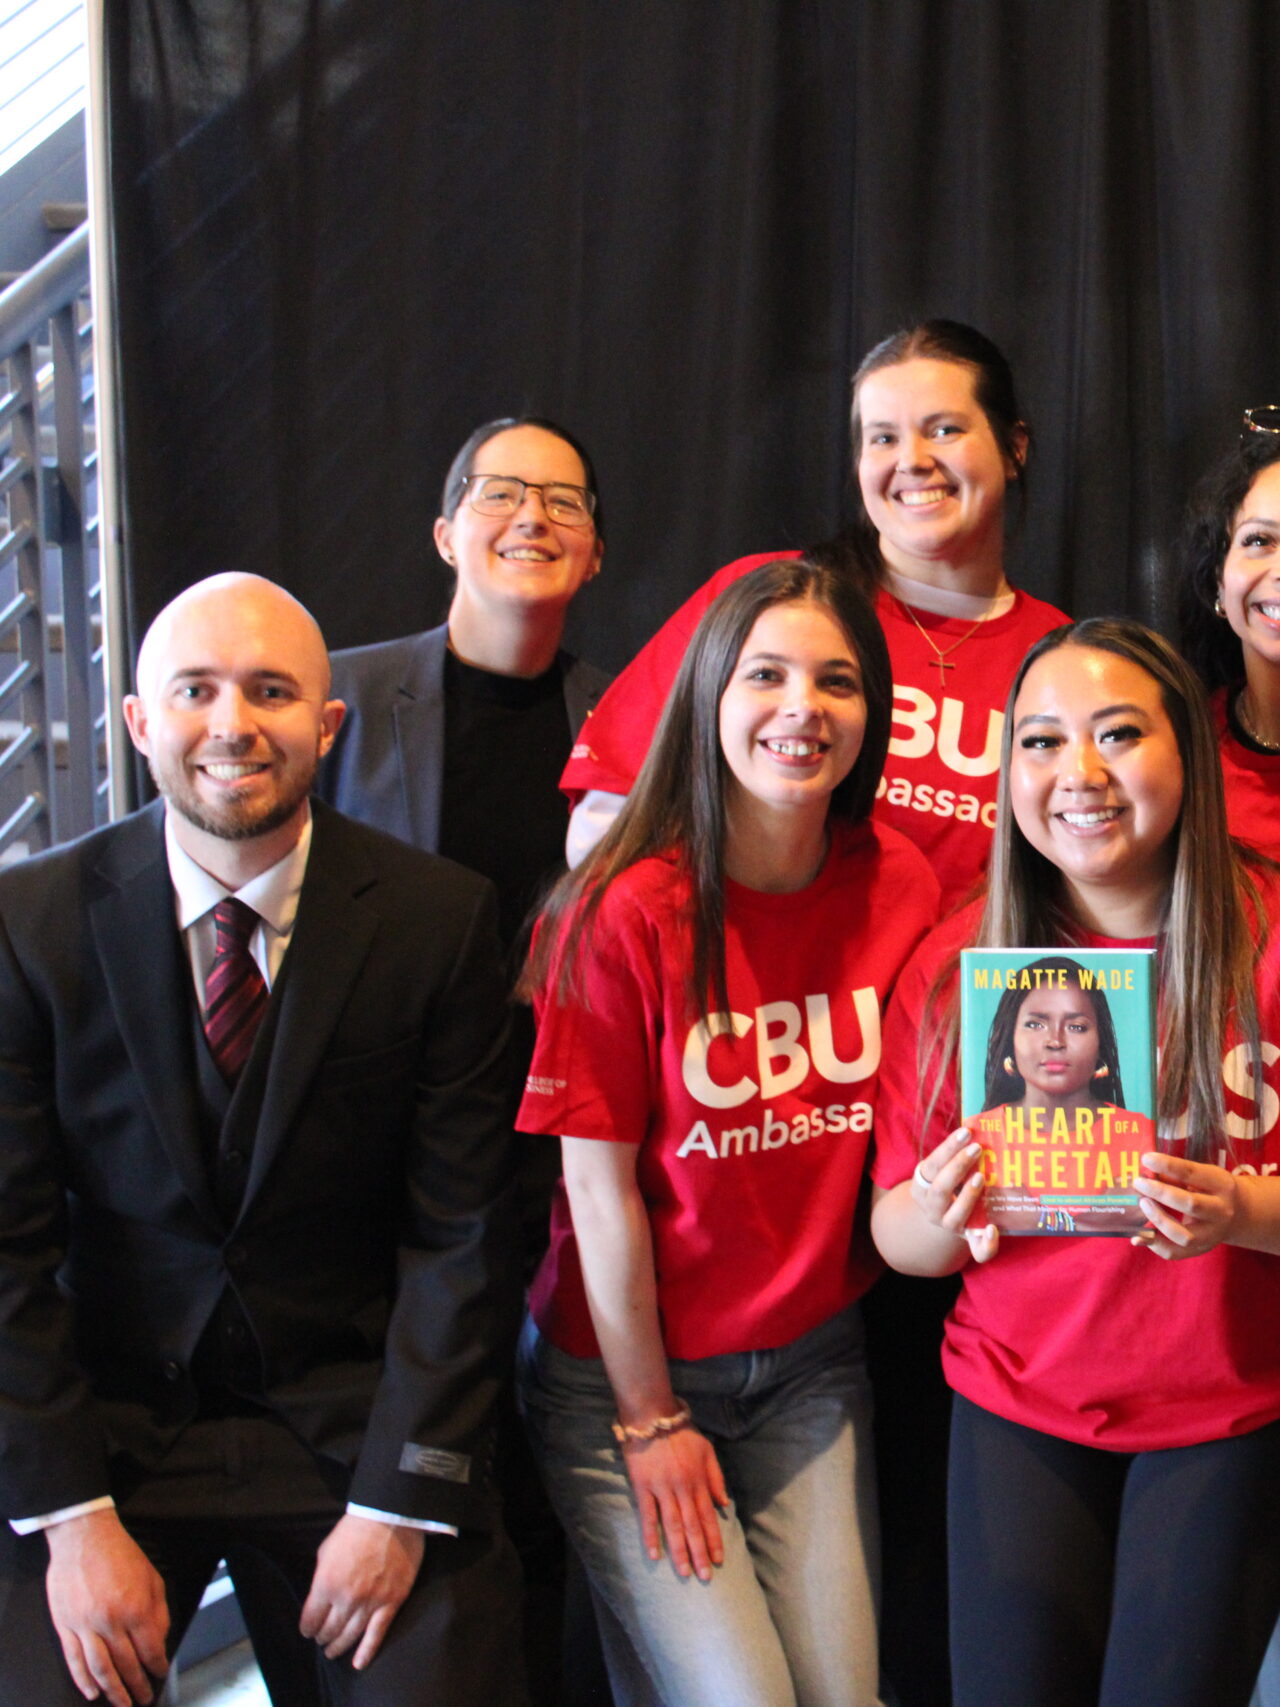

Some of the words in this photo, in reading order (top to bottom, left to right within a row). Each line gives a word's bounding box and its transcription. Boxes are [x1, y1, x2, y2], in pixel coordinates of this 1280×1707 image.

[887, 684, 1005, 777] BU
[974, 969, 1067, 990] MAGATTE
[1078, 969, 1135, 990] WADE
[682, 986, 882, 1109] CBU
[676, 1102, 873, 1159] Ambassa
[980, 1119, 1001, 1132] THE
[1005, 1107, 1116, 1144] HEART
[1114, 1121, 1129, 1134] OF
[1131, 1121, 1139, 1133] A
[979, 1149, 1139, 1188] CHEETAH
